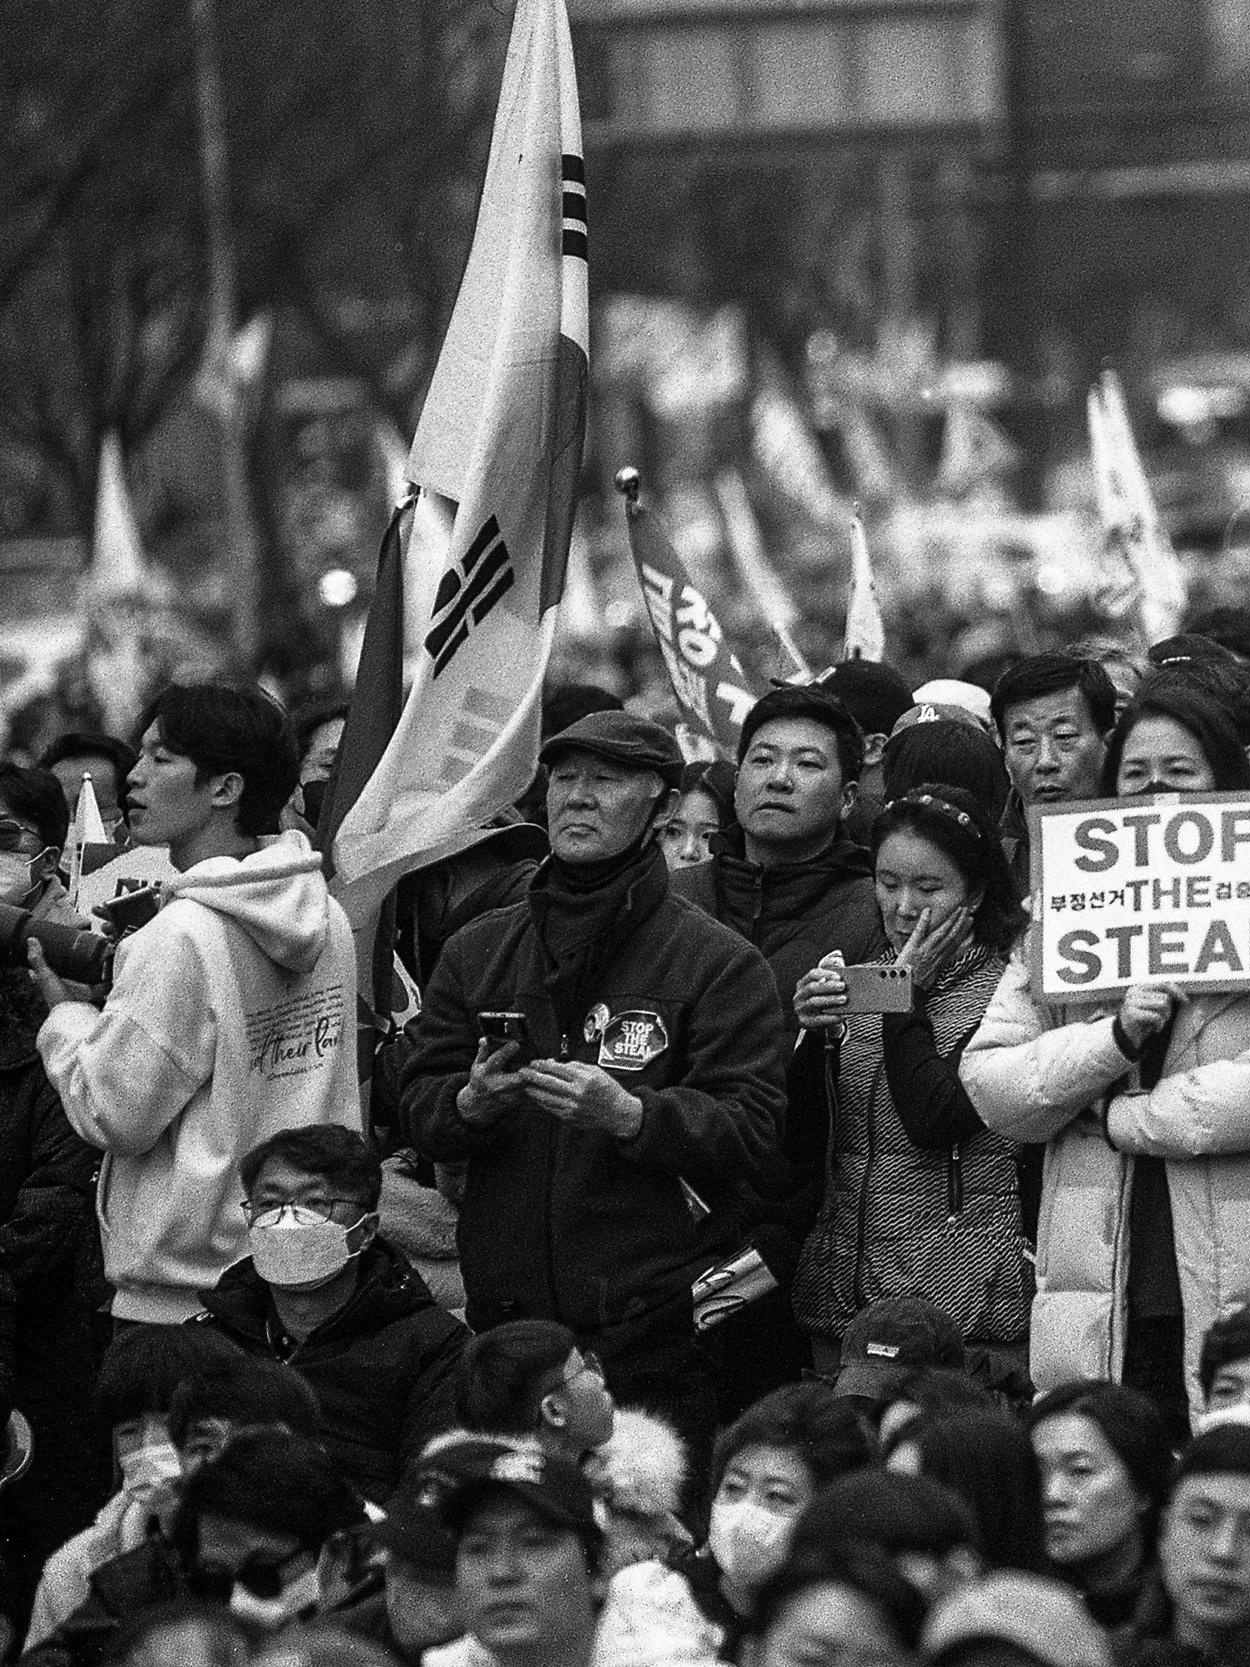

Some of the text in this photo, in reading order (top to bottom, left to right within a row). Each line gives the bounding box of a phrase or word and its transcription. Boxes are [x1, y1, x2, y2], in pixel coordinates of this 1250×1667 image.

[917, 704, 940, 723] LA
[1050, 889, 1126, 912] 부정선거
[1125, 876, 1212, 912] THE
[620, 1021, 655, 1034] STOP
[623, 1032, 649, 1047] THE
